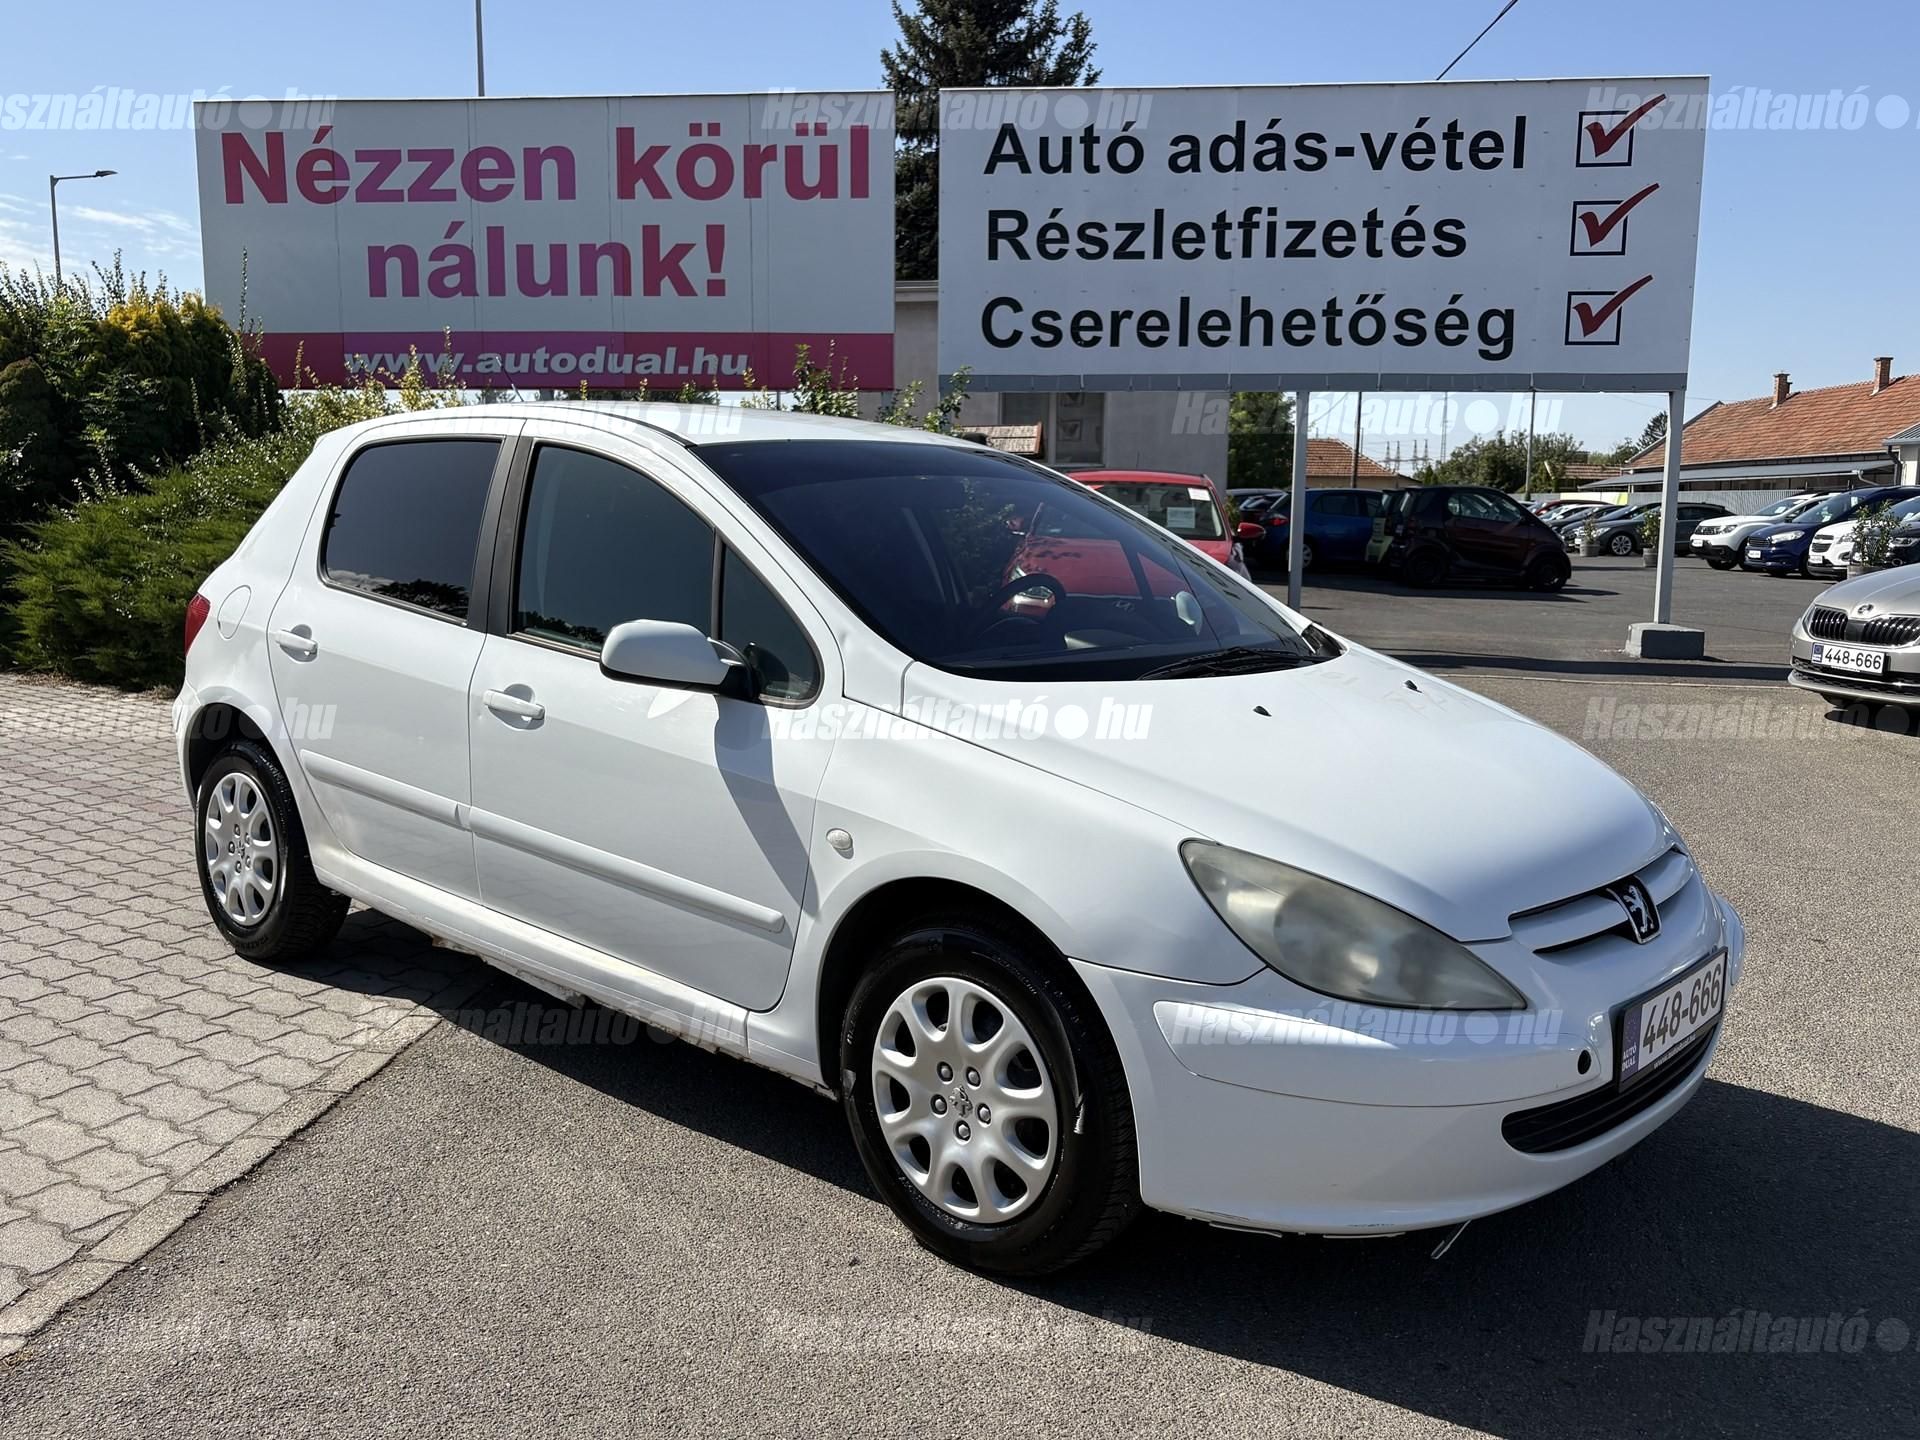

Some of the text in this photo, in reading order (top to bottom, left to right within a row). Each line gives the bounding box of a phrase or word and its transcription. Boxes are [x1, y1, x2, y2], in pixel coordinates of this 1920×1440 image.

[221, 122, 870, 205] Nézzen körül
[984, 116, 1527, 174] Autó adás-vétel
[367, 220, 726, 298] nálunk!
[987, 205, 1467, 261] Részletfizetés
[981, 293, 1515, 361] Cserelehetőség
[343, 345, 749, 376] www.autodual.hu
[1825, 648, 1881, 670] 448-666
[1643, 963, 1722, 1054] 448-666
